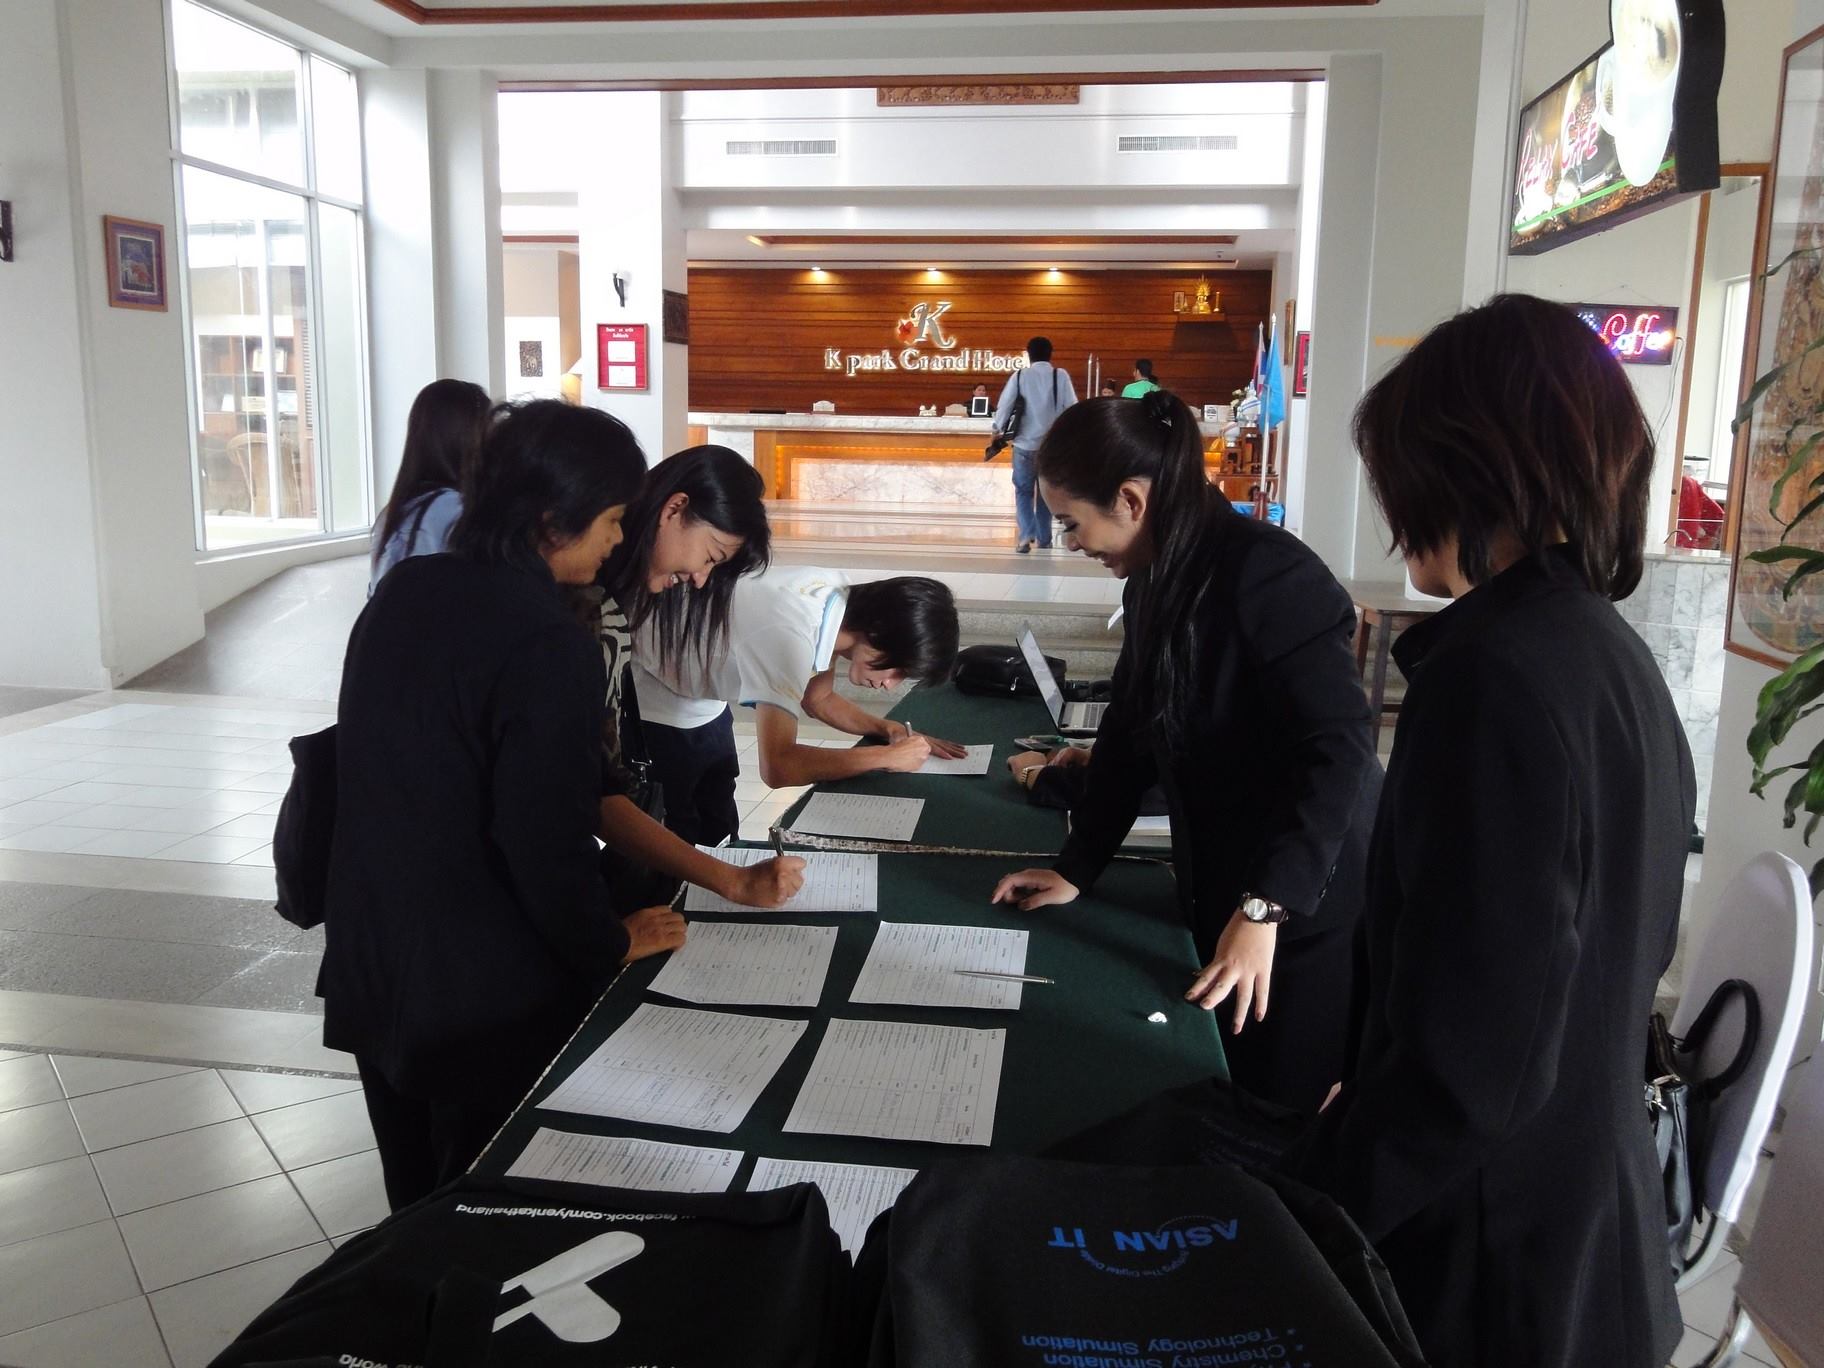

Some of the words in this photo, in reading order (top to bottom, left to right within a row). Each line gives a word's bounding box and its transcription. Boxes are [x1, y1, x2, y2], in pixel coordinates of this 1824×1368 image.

[825, 349, 842, 369] K
[901, 349, 970, 370] Grand
[972, 349, 1031, 371] Hotel
[1047, 1225, 1088, 1249] IT
[1112, 1218, 1239, 1252] ASIAN
[1021, 1334, 1140, 1356] Simulation
[1148, 1327, 1279, 1355] Technology
[1043, 1352, 1163, 1368] Simulation
[1172, 1343, 1287, 1368] Chemistry
